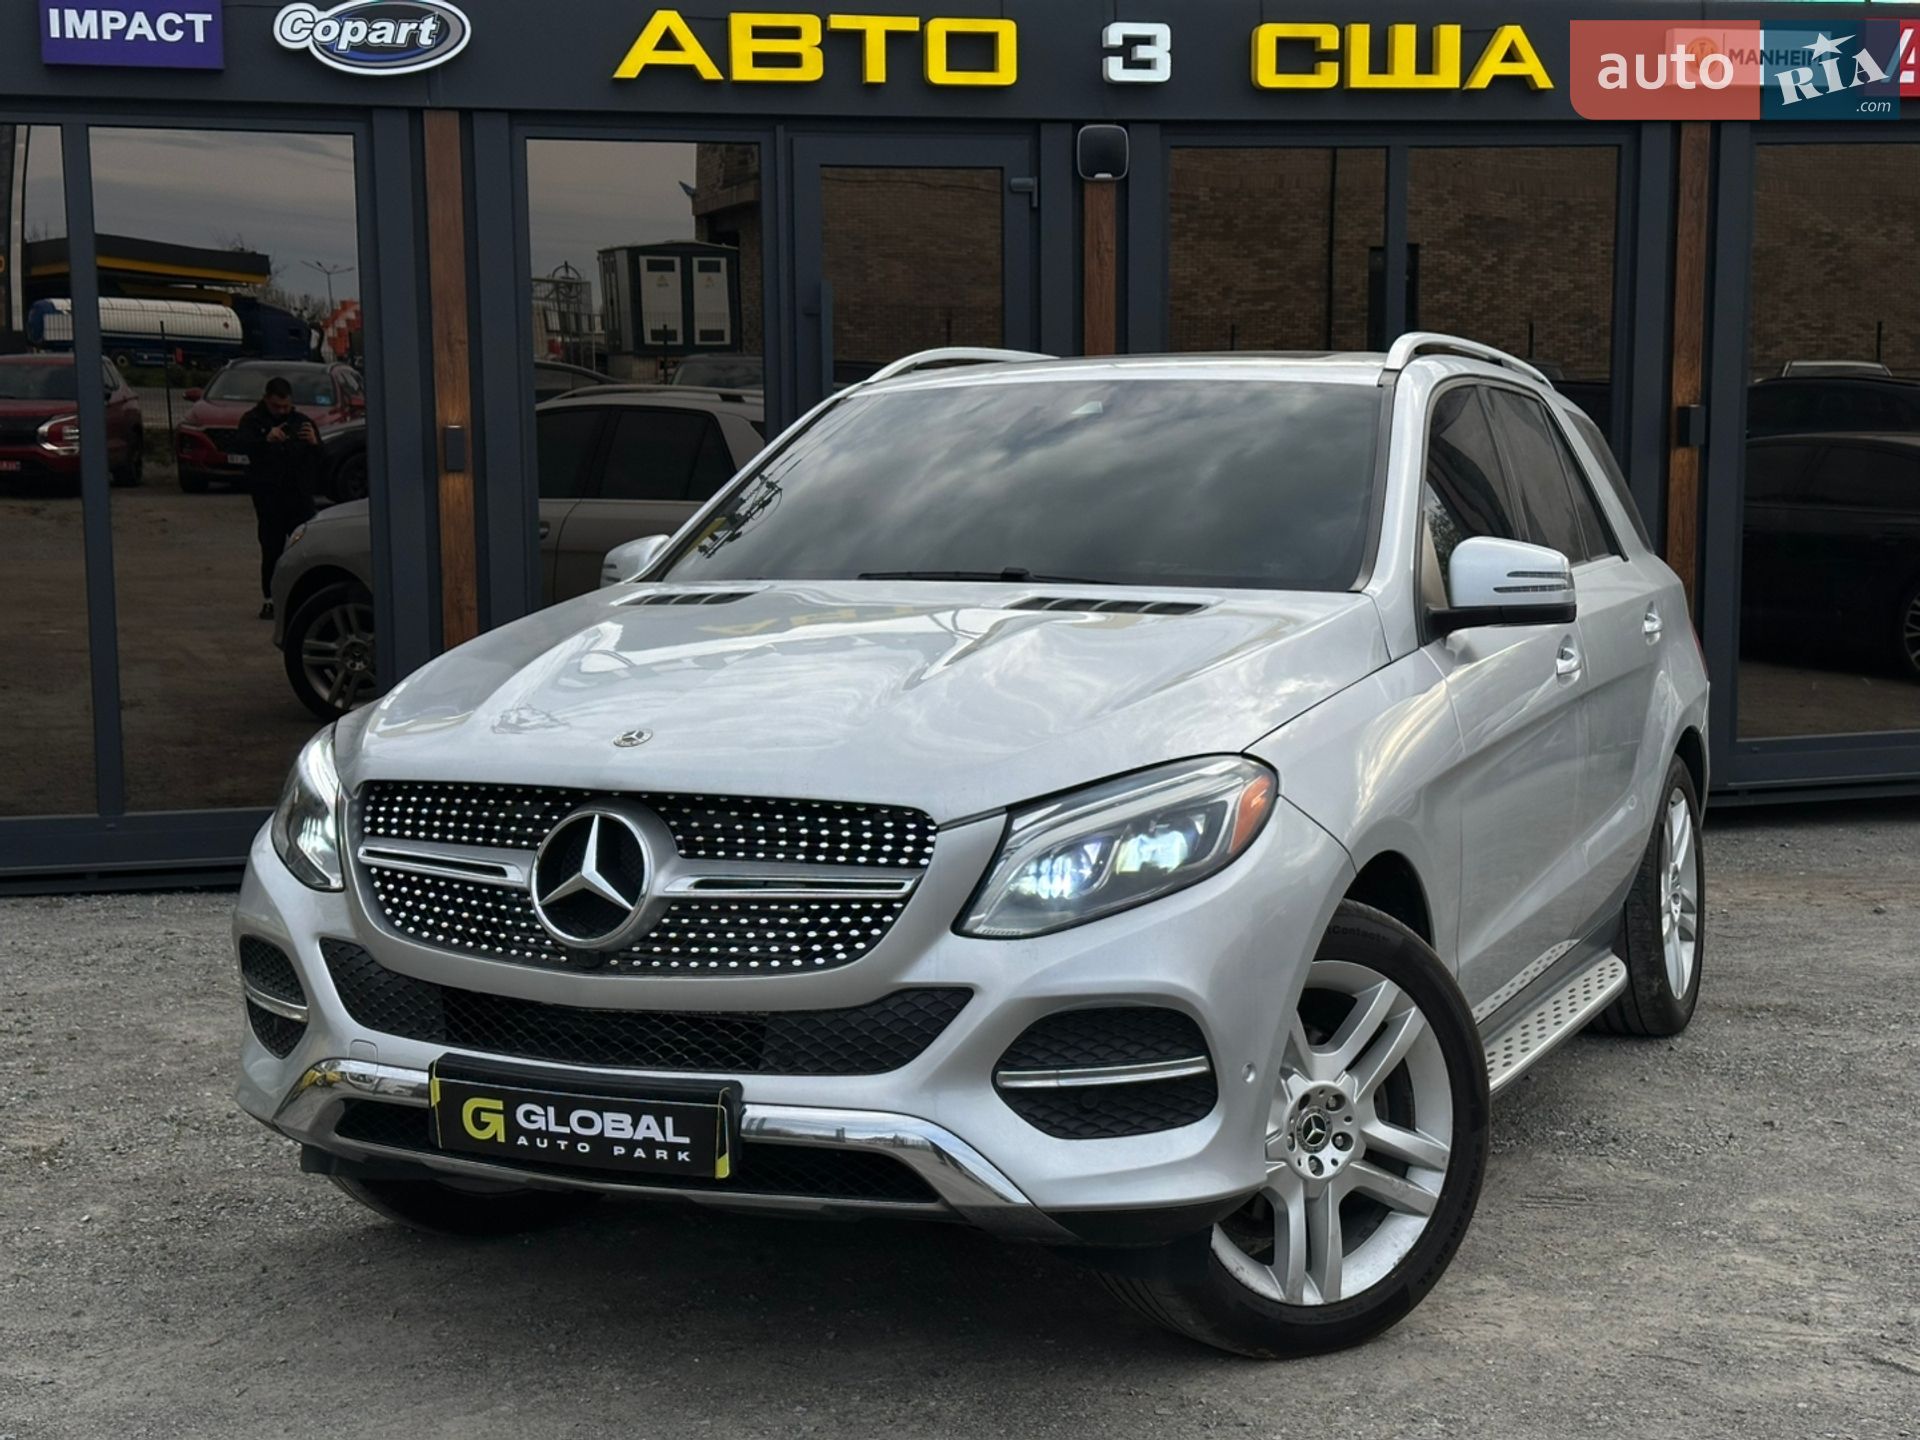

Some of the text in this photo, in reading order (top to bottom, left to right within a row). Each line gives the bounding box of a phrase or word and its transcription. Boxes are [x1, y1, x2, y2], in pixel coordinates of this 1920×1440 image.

[48, 8, 213, 43] IMPACT
[279, 9, 438, 51] Copart
[612, 9, 1018, 86] АВТО
[1251, 22, 1555, 90] США
[515, 1103, 691, 1144] GLOBAL
[516, 1135, 691, 1162] AUTO PARK
